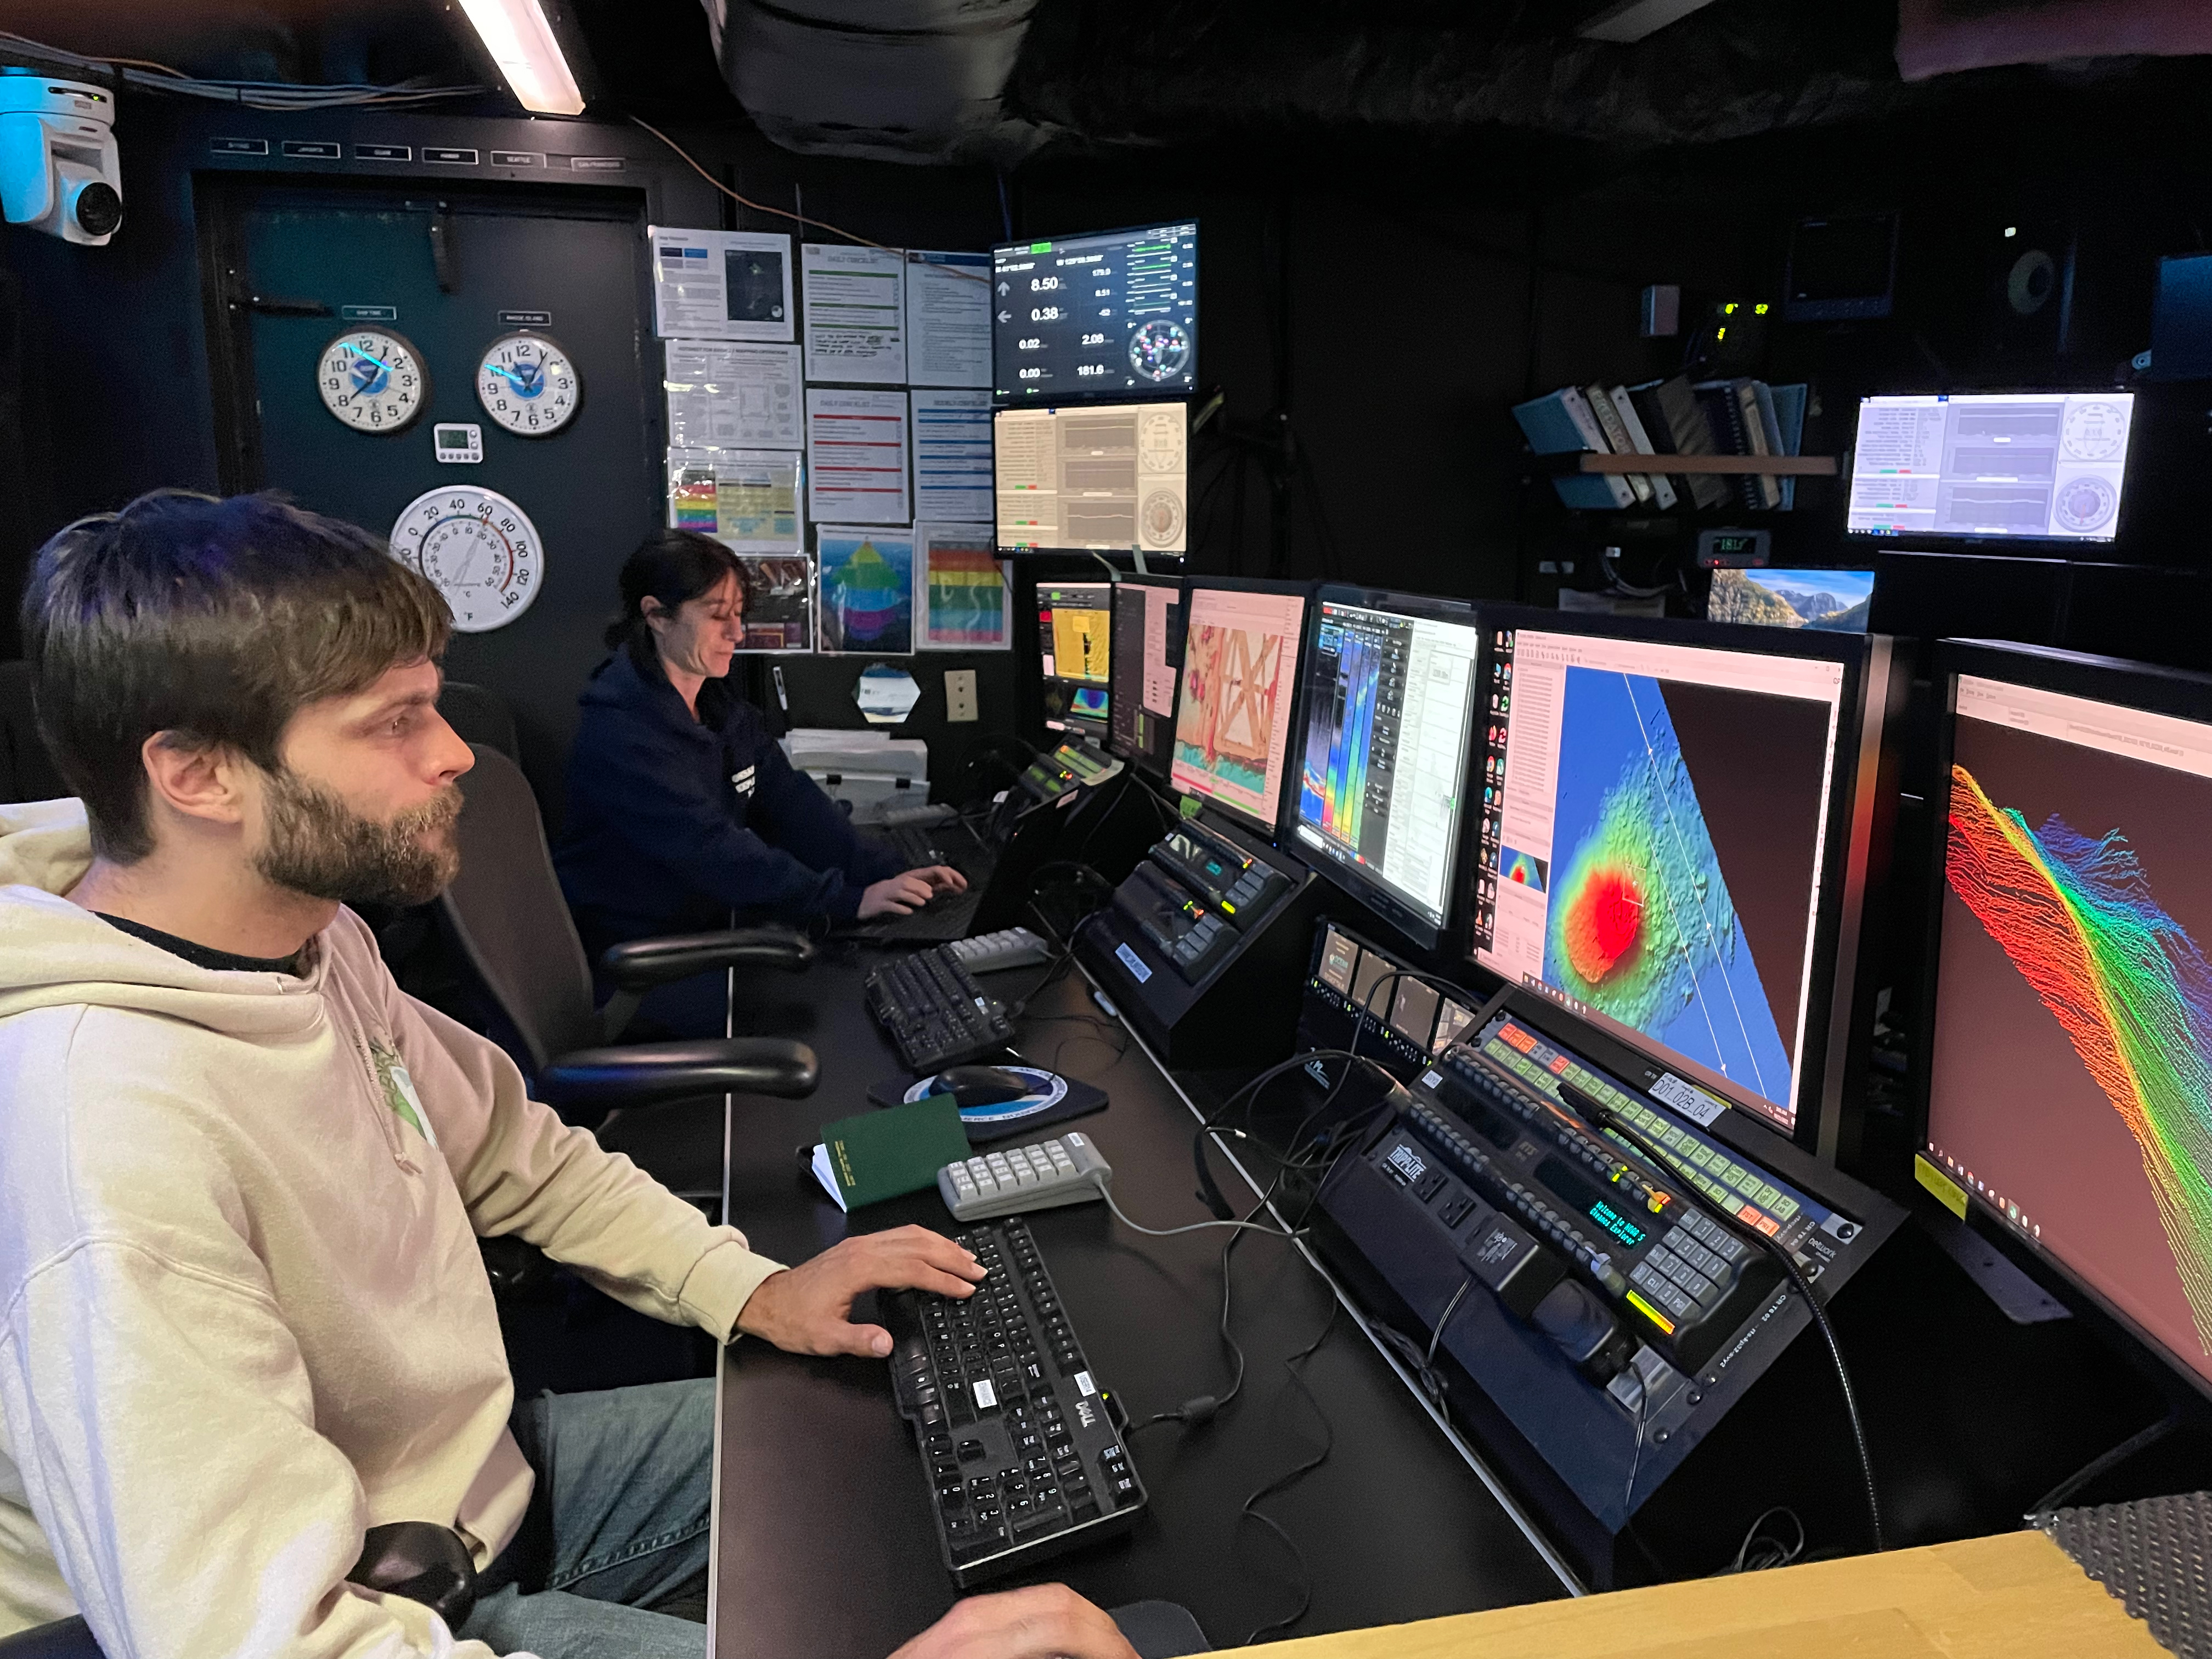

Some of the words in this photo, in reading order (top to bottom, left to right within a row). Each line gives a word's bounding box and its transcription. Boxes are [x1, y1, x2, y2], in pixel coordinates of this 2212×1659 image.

[1031, 276, 1058, 291] 8.50
[1031, 307, 1059, 321] 0.38
[359, 340, 373, 352] 12
[1019, 338, 1040, 349] 0.02
[516, 345, 531, 356] 12
[501, 352, 512, 363] 11
[331, 360, 346, 372] 10
[394, 358, 404, 369] 2
[1019, 368, 1040, 379] 0.00
[329, 378, 339, 390] 9
[402, 375, 412, 386] 3
[557, 378, 568, 389] 3
[488, 383, 498, 394] 9
[338, 395, 348, 406] 8
[399, 393, 408, 403] 4
[555, 396, 565, 405] 4
[496, 399, 507, 410] 8
[353, 407, 363, 417] 7
[387, 405, 398, 416] 5
[511, 410, 520, 421] 7
[544, 408, 554, 419] 5
[371, 411, 381, 422] 6
[528, 415, 538, 426] 6
[449, 499, 465, 509] 40
[477, 503, 493, 516] 60
[424, 506, 439, 520] 20
[500, 518, 516, 532] 80
[515, 541, 528, 558] 100
[517, 569, 529, 585] 120
[500, 592, 519, 608] 140
[1652, 1080, 1711, 1120] D01_02B_04
[1774, 1204, 1785, 1214] LAB
[1616, 1216, 1626, 1227] to
[1804, 1220, 1816, 1232] CR
[1609, 1222, 1636, 1246] Explorer
[1713, 1235, 1722, 1244] 2
[1683, 1243, 1690, 1251] 4
[1808, 1238, 1837, 1259] network
[1666, 1261, 1673, 1269] 7
[1079, 1375, 1092, 1392] USER14
[1075, 1401, 1096, 1427] DELL
